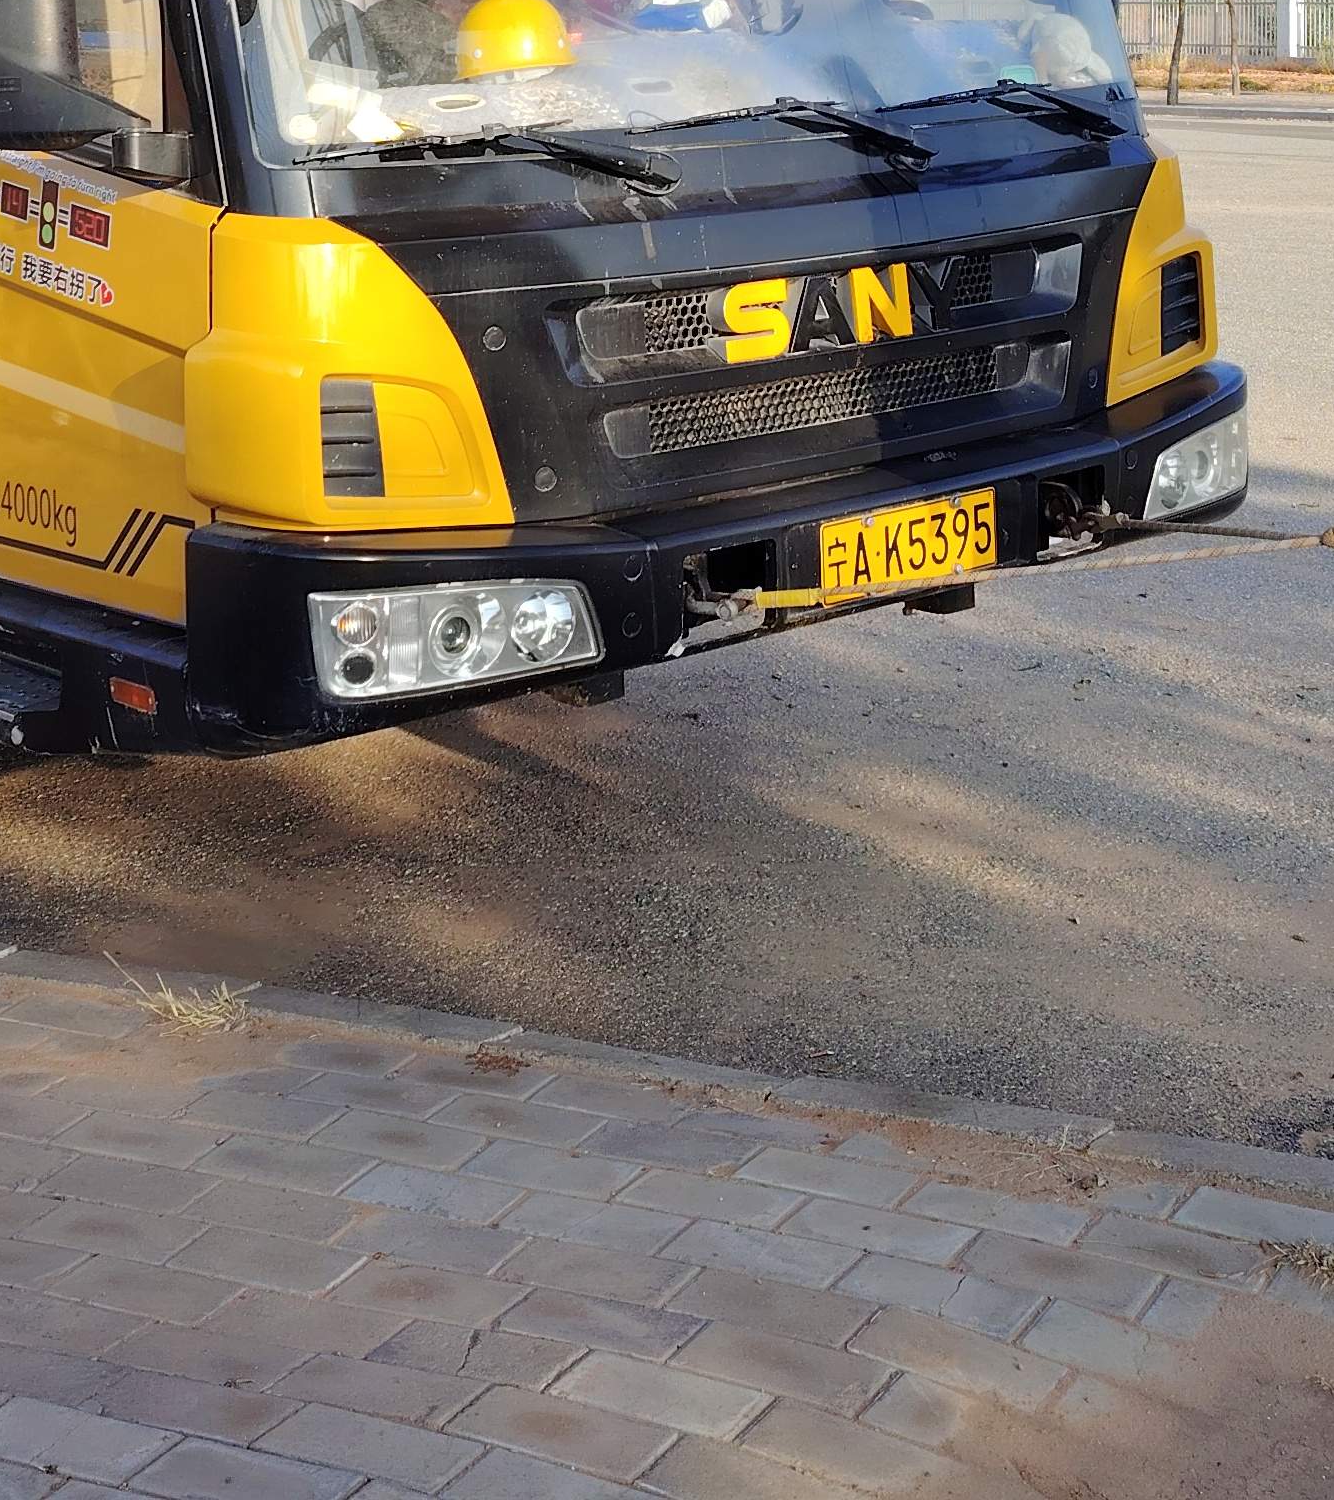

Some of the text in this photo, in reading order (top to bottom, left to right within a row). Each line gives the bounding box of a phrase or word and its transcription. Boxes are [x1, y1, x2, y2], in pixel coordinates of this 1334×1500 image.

[73, 209, 107, 242] 520
[22, 254, 102, 302] 我要右拐了
[723, 256, 965, 364] SANY
